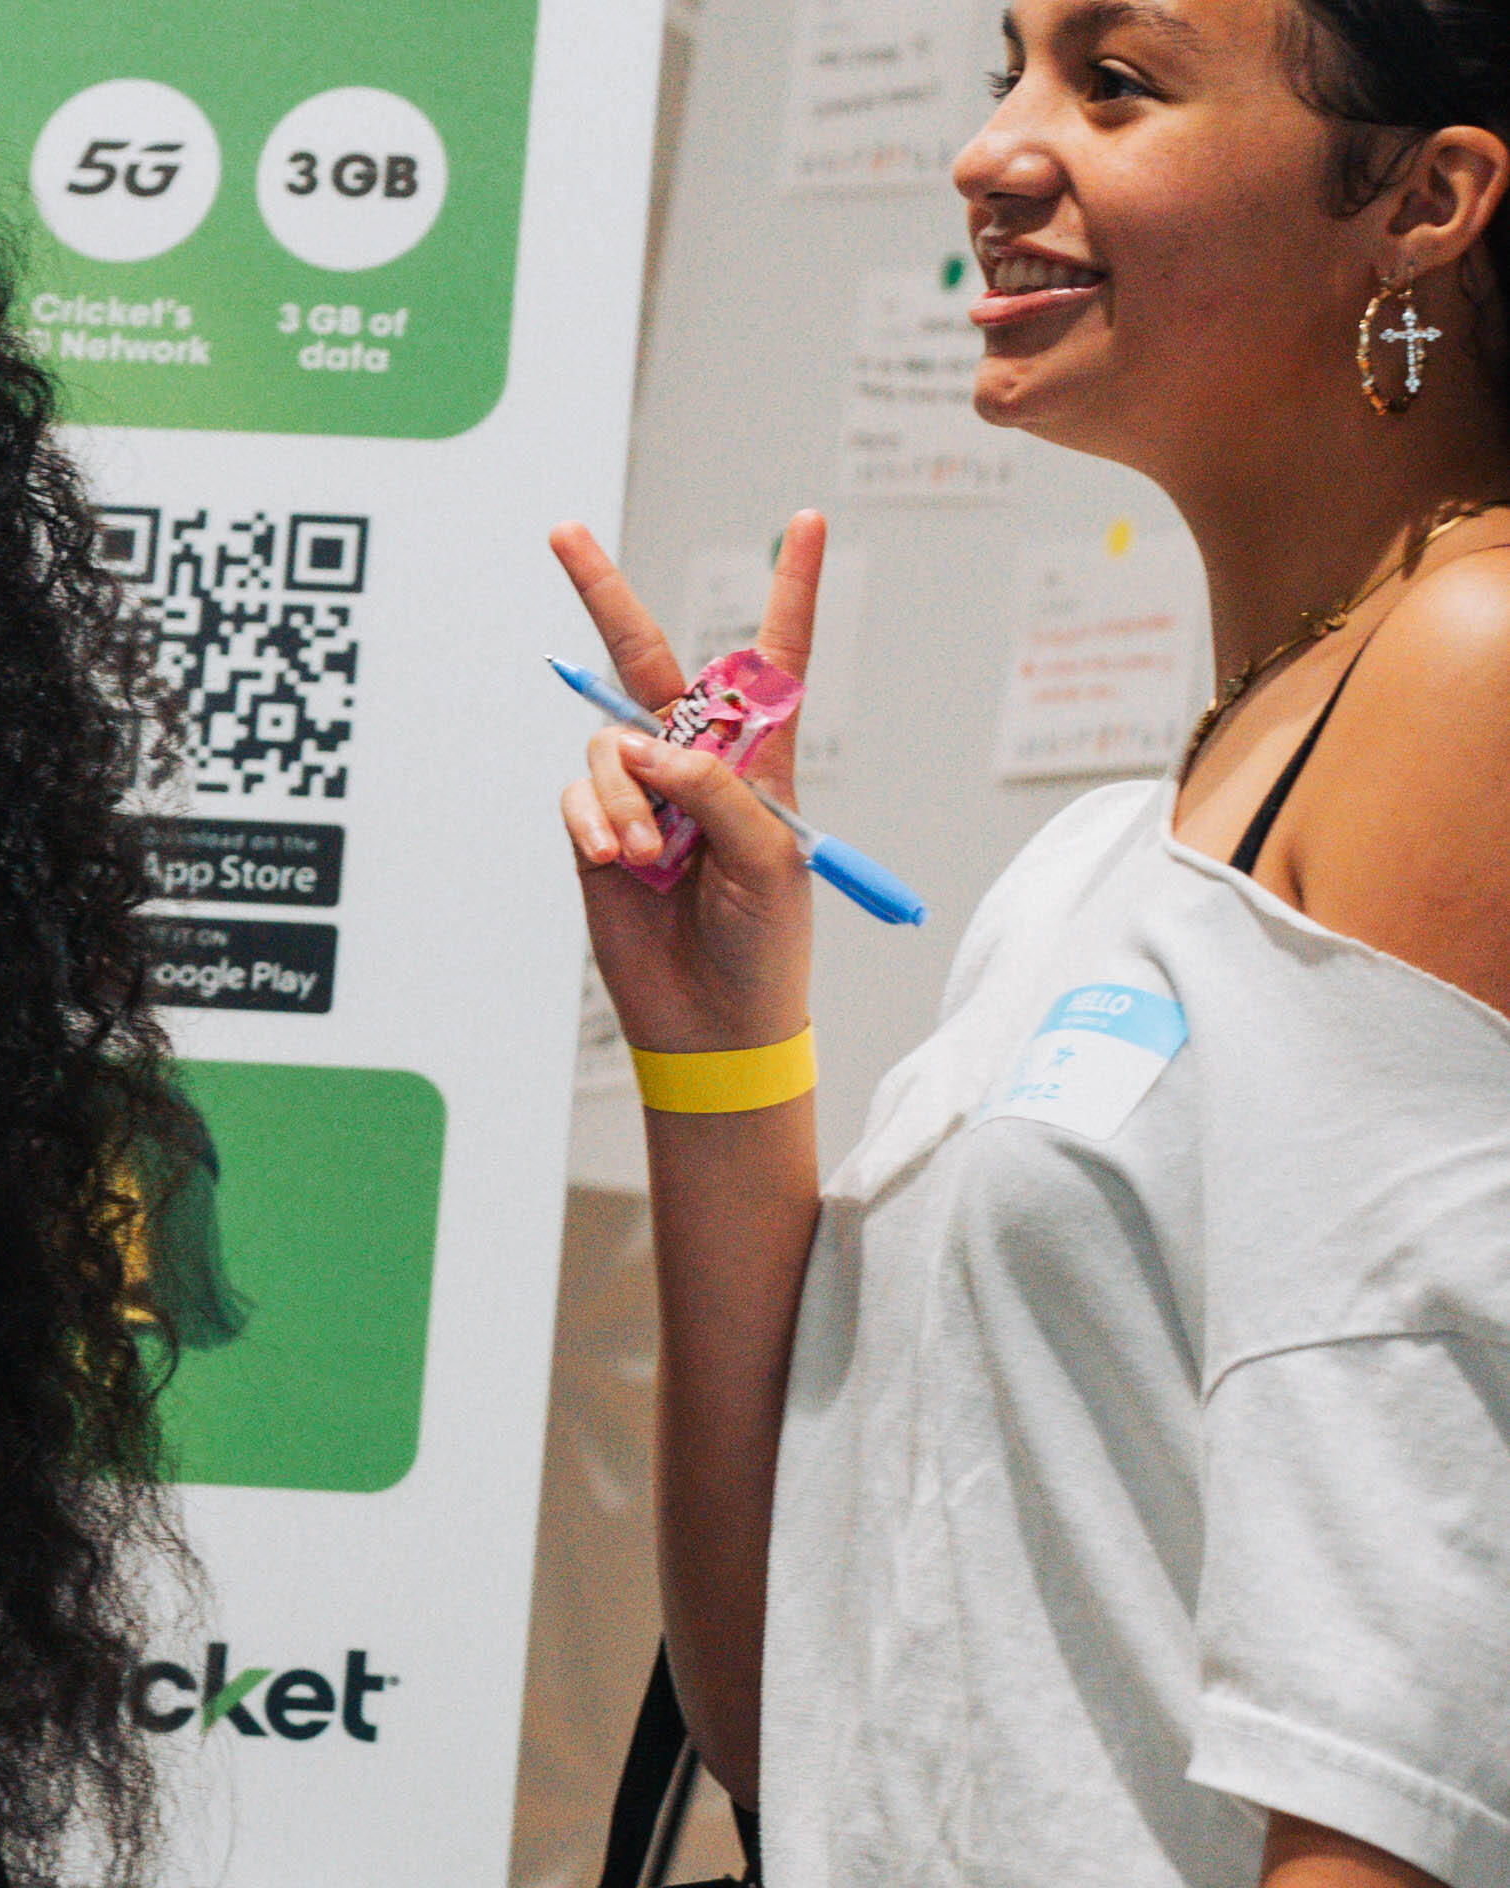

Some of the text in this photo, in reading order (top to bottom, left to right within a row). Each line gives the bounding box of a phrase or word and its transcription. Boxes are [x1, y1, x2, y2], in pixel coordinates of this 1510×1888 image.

[65, 138, 185, 197] 5G
[285, 149, 419, 200] 3 GB
[30, 293, 194, 330] Cricket's
[276, 302, 409, 339] 3 GB of
[57, 329, 211, 366] Network
[297, 340, 391, 375] data
[219, 854, 318, 894] Store
[152, 957, 319, 1000] oogle Play
